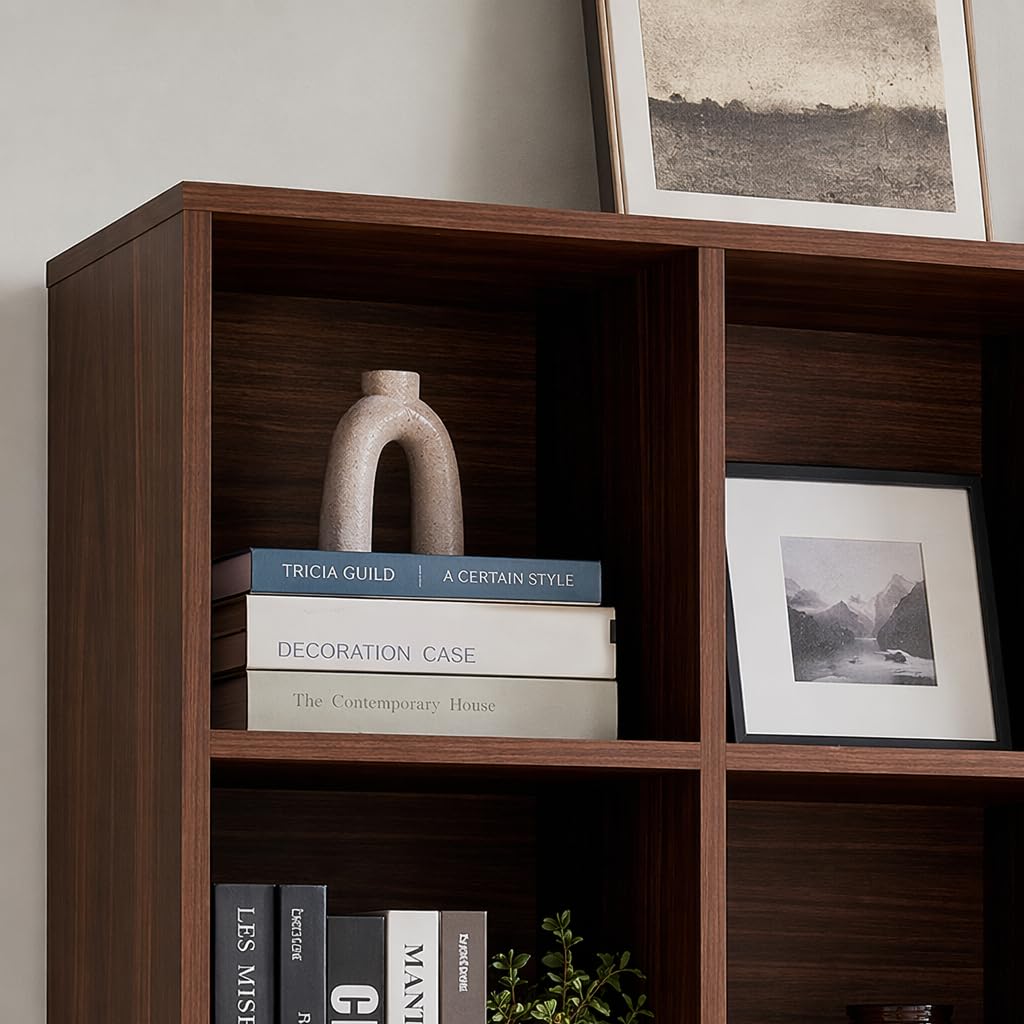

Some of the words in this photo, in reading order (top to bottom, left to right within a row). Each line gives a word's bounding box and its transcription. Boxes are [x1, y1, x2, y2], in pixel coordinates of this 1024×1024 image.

[282, 563, 338, 579] TRICIA
[343, 566, 396, 582] GUILD
[442, 570, 455, 583] A
[458, 570, 524, 585] CERTAIN
[528, 572, 575, 587] STYLE
[278, 641, 411, 662] DECORATION
[422, 646, 477, 664] CASE
[292, 692, 324, 709] The
[331, 694, 441, 714] Contemporary
[449, 697, 497, 713] House
[237, 906, 256, 952] LES
